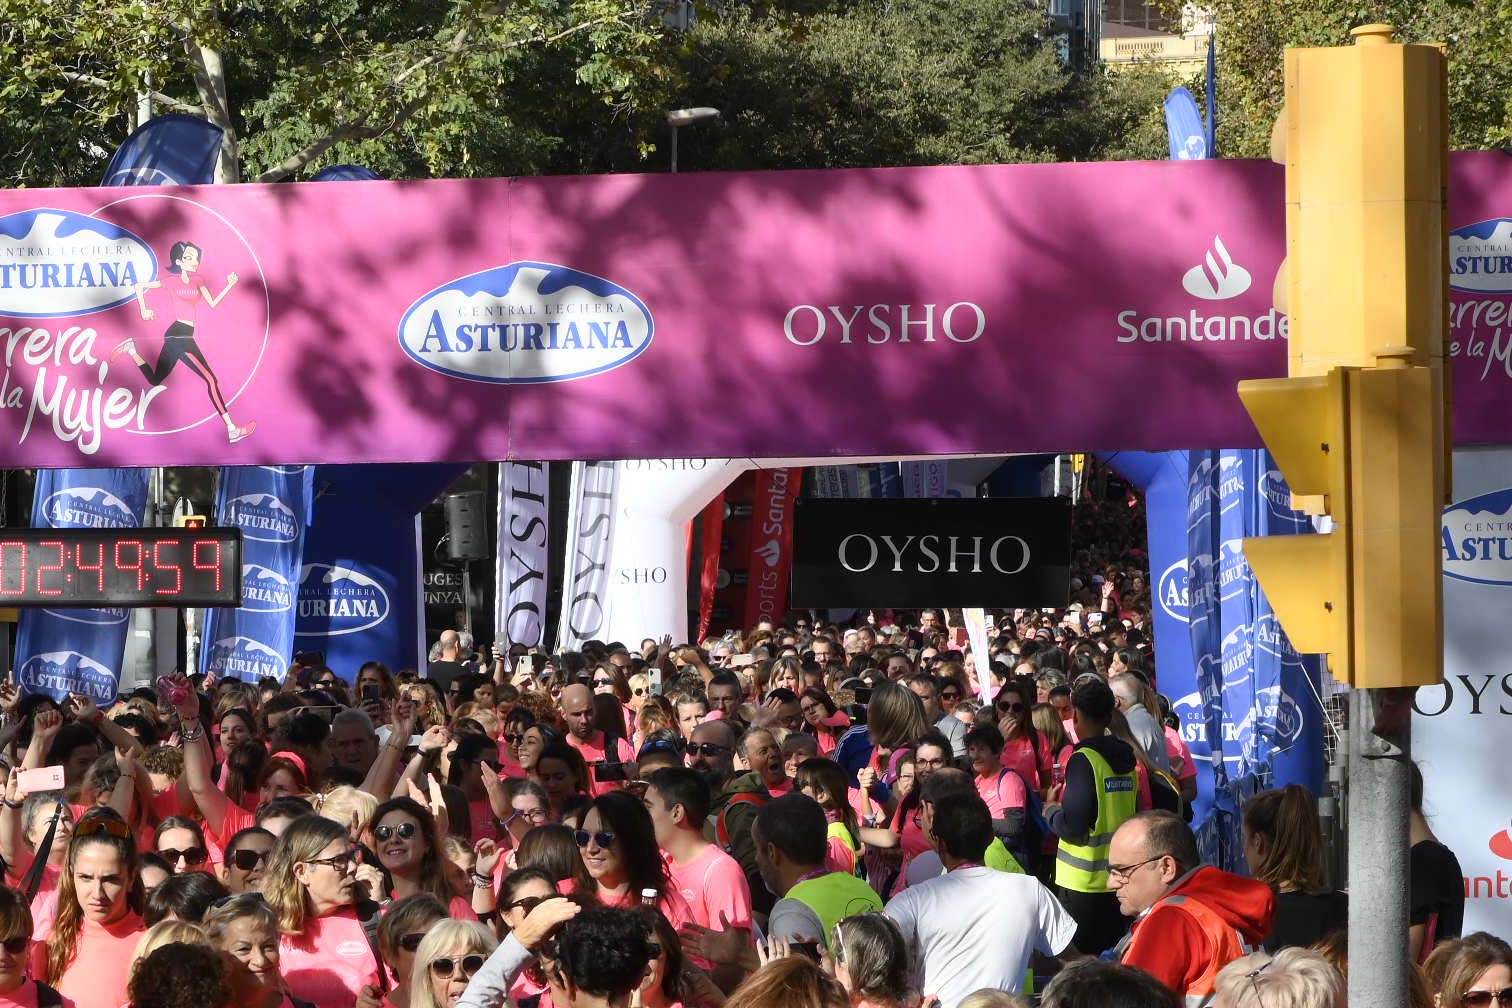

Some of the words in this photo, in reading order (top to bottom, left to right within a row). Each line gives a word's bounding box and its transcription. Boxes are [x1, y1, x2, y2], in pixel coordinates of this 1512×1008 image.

[59, 245, 134, 257] LECHERA
[1449, 256, 1512, 275] STUR
[458, 305, 536, 317] CENTRAL
[544, 303, 626, 315] LECHERA
[783, 301, 986, 346] OYSHO
[1116, 309, 1289, 343] Santande
[419, 309, 634, 353] ASTURIANA
[0, 369, 24, 409] la
[19, 360, 169, 455] Mujer
[762, 467, 788, 535] Santa
[506, 461, 548, 648] OYSH
[569, 462, 615, 640] OYSH
[838, 533, 1031, 574] OYSHO
[619, 567, 667, 584] SHO
[242, 585, 289, 605] URIANA
[299, 598, 380, 618] URIANA
[758, 571, 778, 622] ports
[25, 664, 112, 700] ASTURIANA
